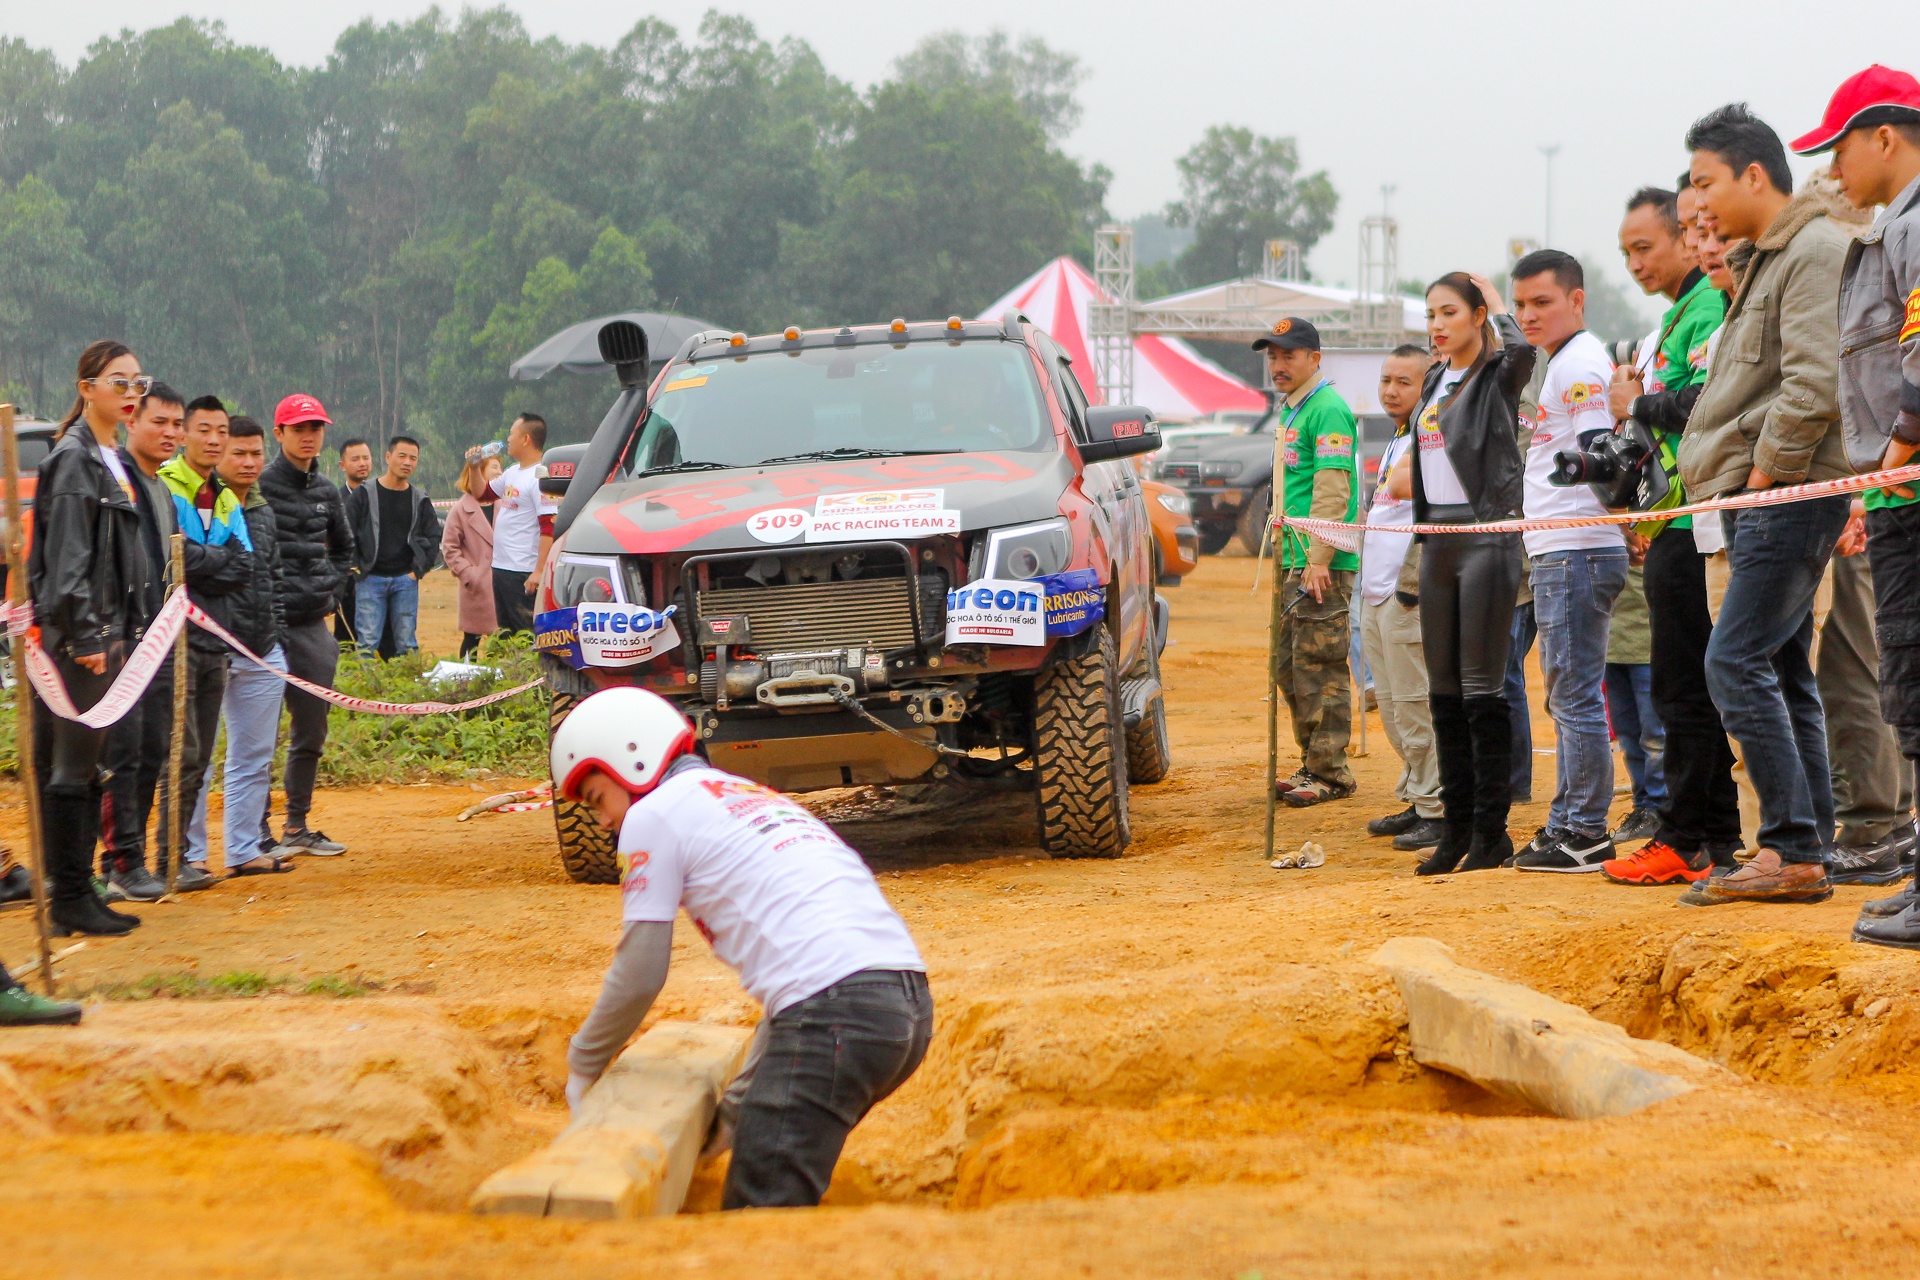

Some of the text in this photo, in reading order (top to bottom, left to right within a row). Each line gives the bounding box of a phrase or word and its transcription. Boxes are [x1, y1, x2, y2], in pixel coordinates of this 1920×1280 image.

[1115, 424, 1139, 436] PAC
[822, 503, 936, 514] MINH GIANG
[755, 514, 803, 531] 509
[813, 518, 955, 532] PAC RACING TEAM 2
[976, 613, 982, 622] Ô
[984, 614, 993, 622] TÔ
[993, 614, 1003, 623] SỐ
[1009, 614, 1021, 624] THẾ
[1021, 616, 1037, 625] GIỚI
[1047, 610, 1086, 625] Lubricants
[619, 638, 628, 646] TÔ
[629, 636, 641, 646] SỐ
